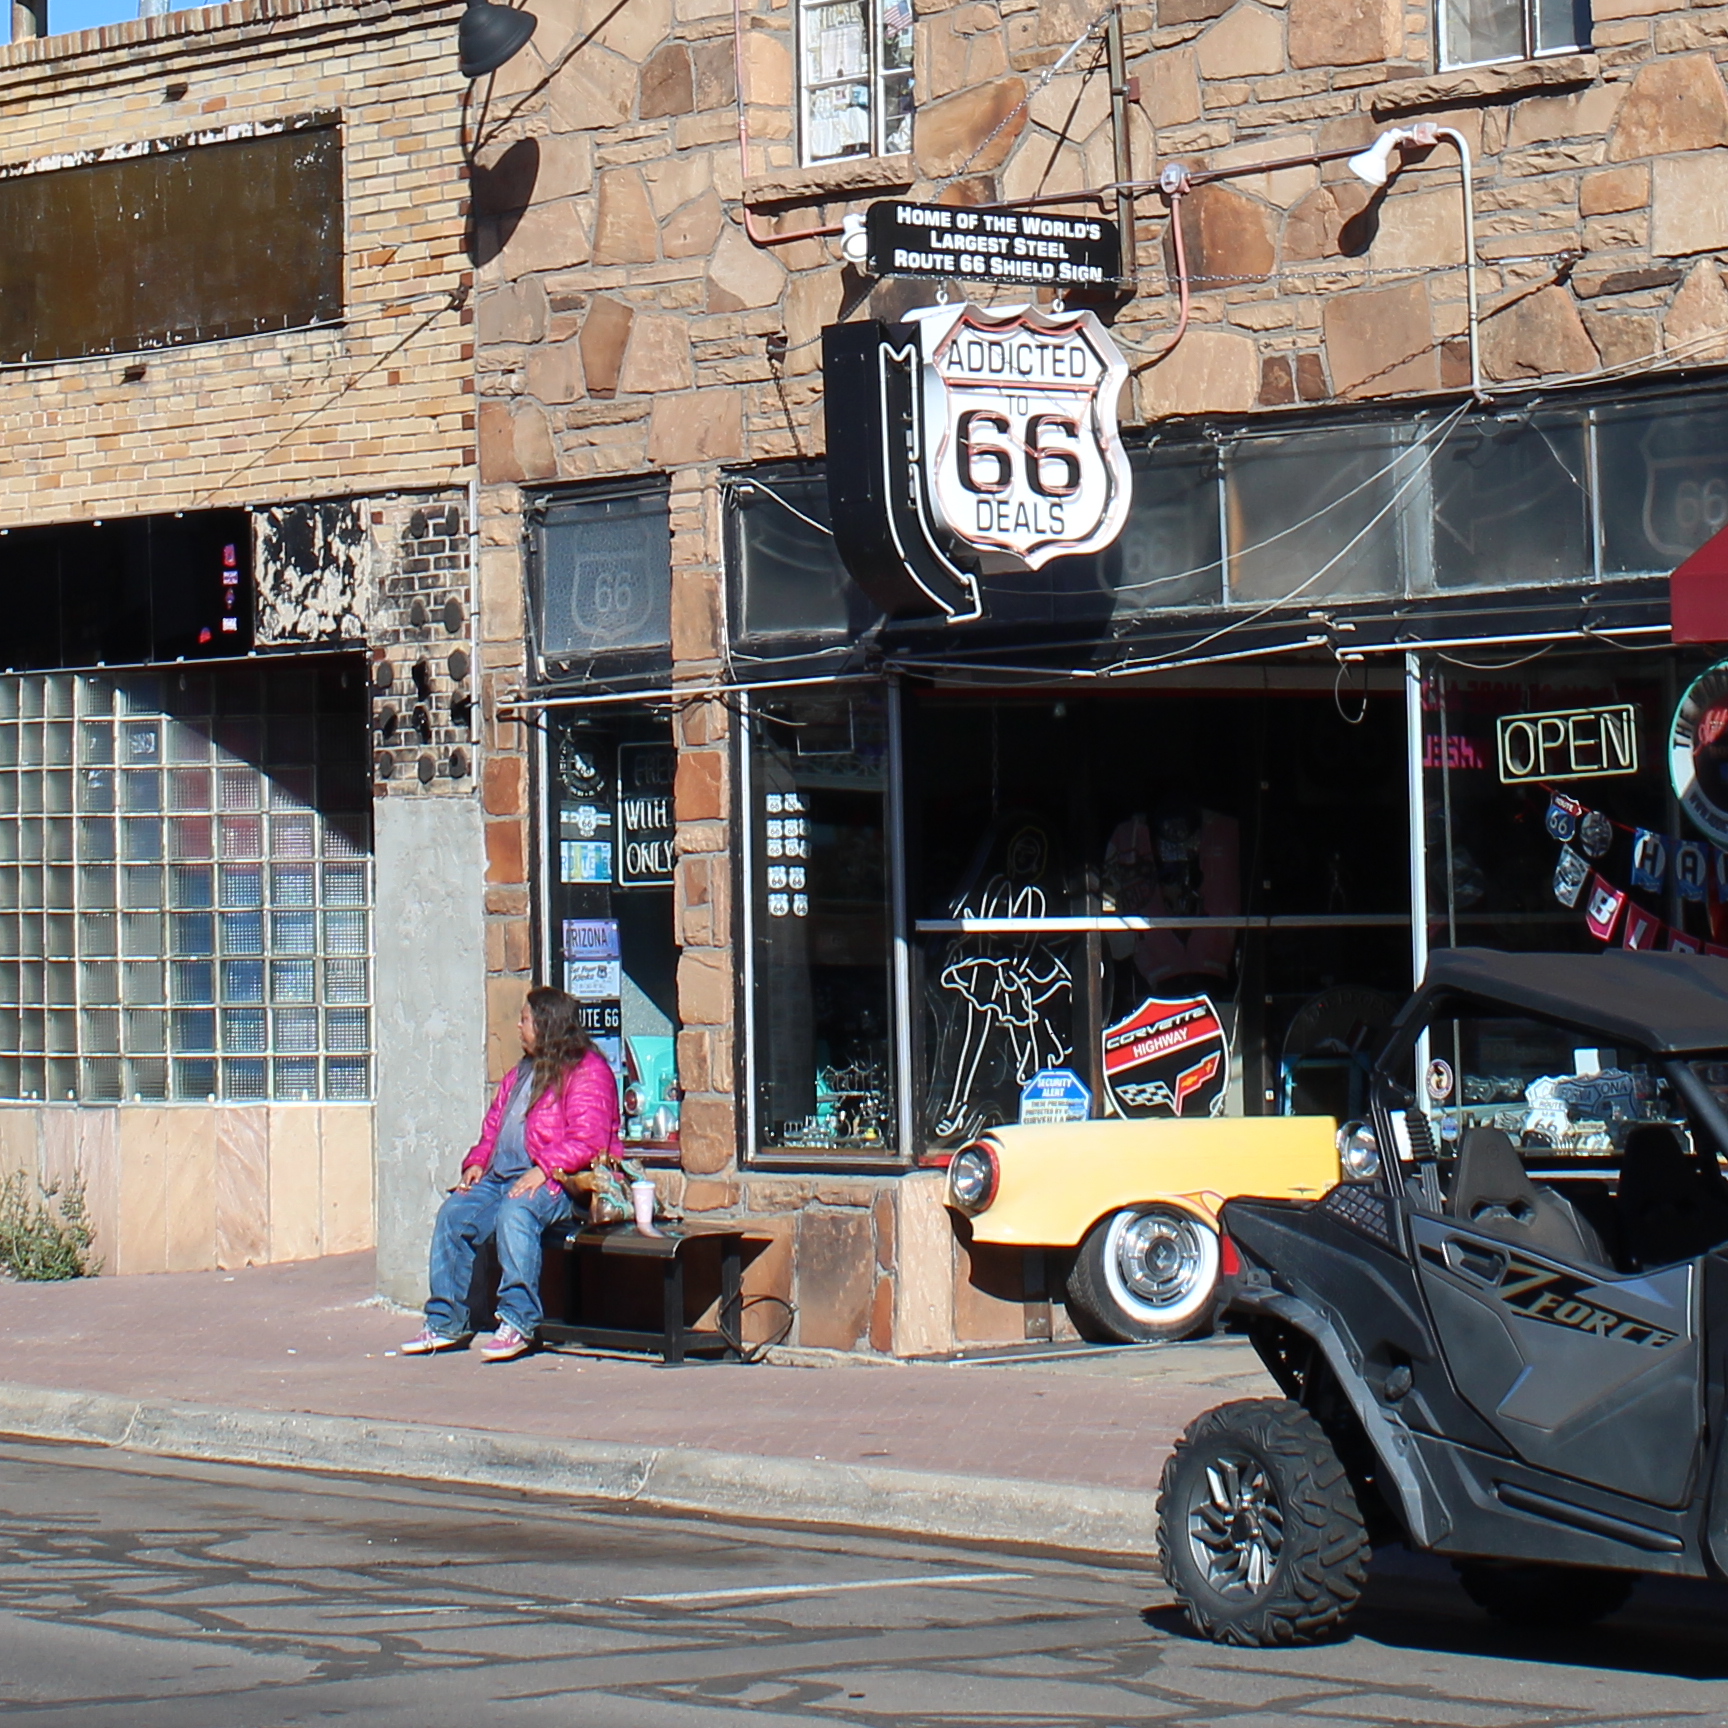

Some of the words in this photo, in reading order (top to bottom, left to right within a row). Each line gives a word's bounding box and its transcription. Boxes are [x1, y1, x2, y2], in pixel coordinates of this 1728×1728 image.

[896, 205, 952, 228] HOME
[956, 212, 980, 231] OF
[983, 214, 1017, 234] THE
[1020, 216, 1102, 240] WORLD'S
[930, 230, 1011, 254] LARGEST
[1013, 237, 1069, 259] STEEL
[894, 249, 955, 272] ROUTE
[960, 253, 985, 273] 66
[989, 256, 1055, 281] SHIELD
[1058, 262, 1103, 284] SIGN
[946, 339, 1087, 378] ADDICTED
[1007, 394, 1029, 416] TO
[956, 409, 1084, 498] 66
[975, 500, 1065, 535] DEALS
[1504, 713, 1633, 775] OPEN
[624, 798, 669, 831] WITH
[1549, 810, 1568, 835] 66
[565, 927, 608, 949] ARIZONA
[604, 1008, 619, 1028] 66
[1105, 1005, 1208, 1052] CORVETTE
[1132, 1027, 1189, 1059] HIGHWAY
[1041, 1087, 1065, 1097] ALERT
[1538, 1099, 1564, 1110] ROUTE
[1534, 1118, 1558, 1135] 66
[1527, 1290, 1675, 1351] FORCE
